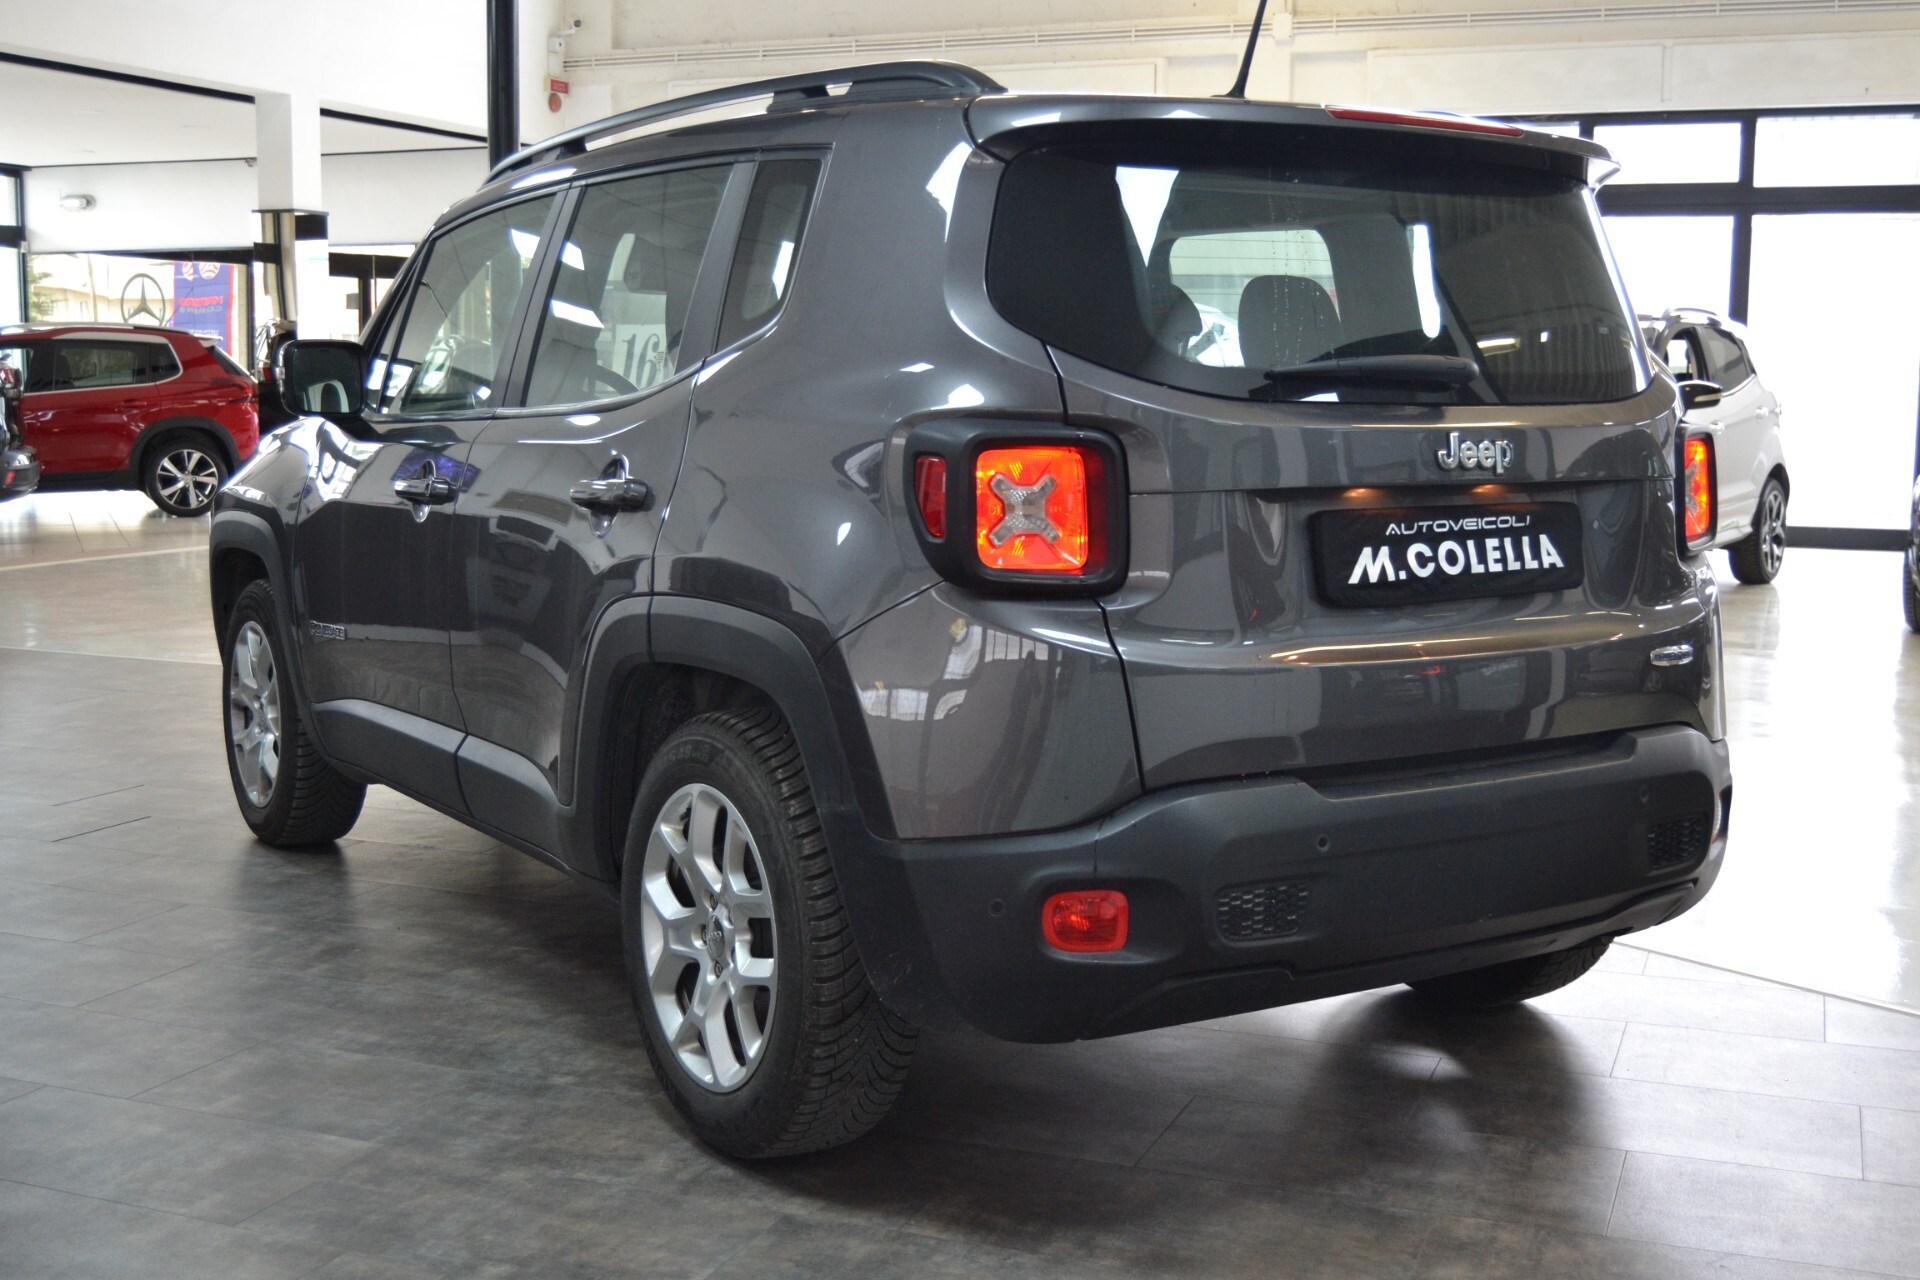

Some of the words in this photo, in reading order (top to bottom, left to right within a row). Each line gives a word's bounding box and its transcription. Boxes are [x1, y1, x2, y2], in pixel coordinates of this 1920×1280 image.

[621, 333, 660, 389] 16
[1436, 431, 1514, 476] Jeep
[1385, 515, 1530, 536] AUTOVEICOLI
[1347, 533, 1565, 585] M.COLELLA
